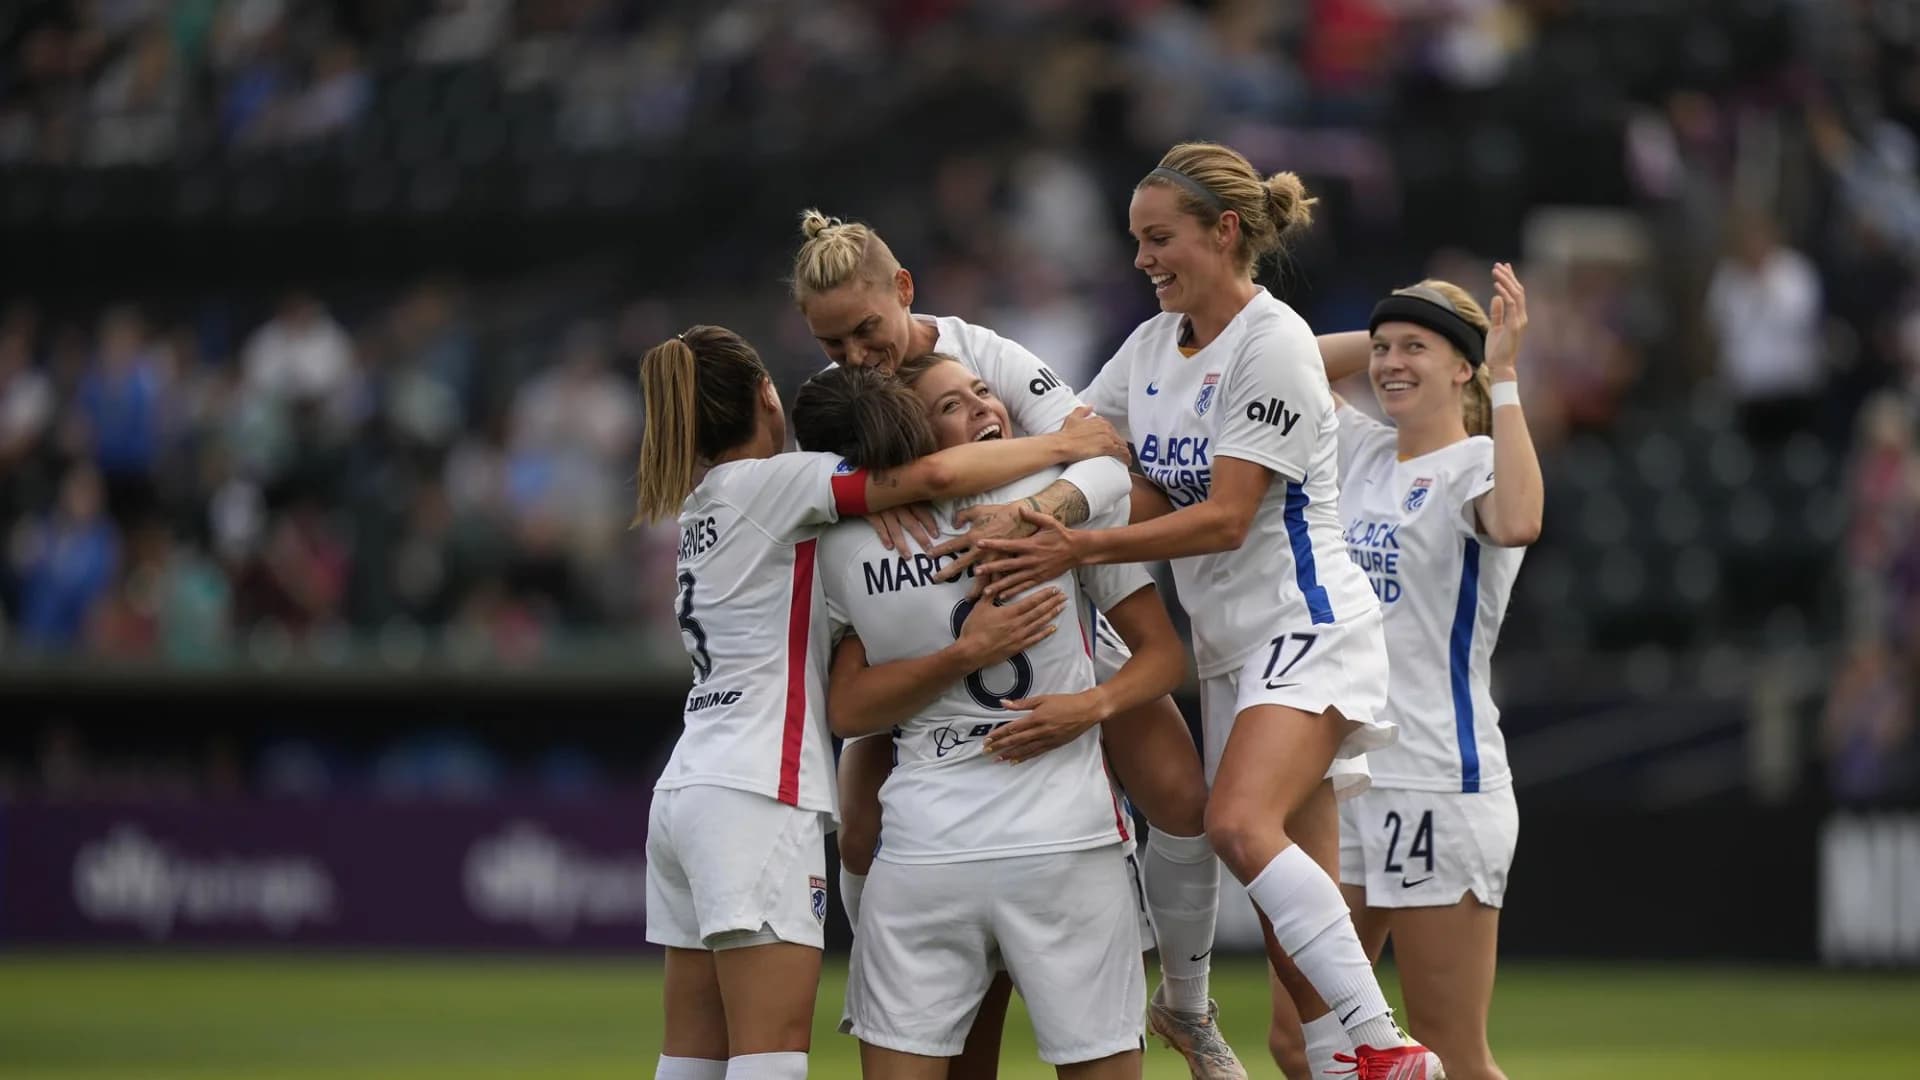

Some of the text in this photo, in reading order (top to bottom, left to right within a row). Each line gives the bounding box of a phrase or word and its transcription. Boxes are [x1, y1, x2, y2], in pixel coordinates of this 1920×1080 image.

[1029, 367, 1062, 396] all
[1246, 398, 1300, 437] ally
[679, 516, 718, 561] RNES
[1261, 632, 1319, 680] 17
[1384, 809, 1434, 873] 24
